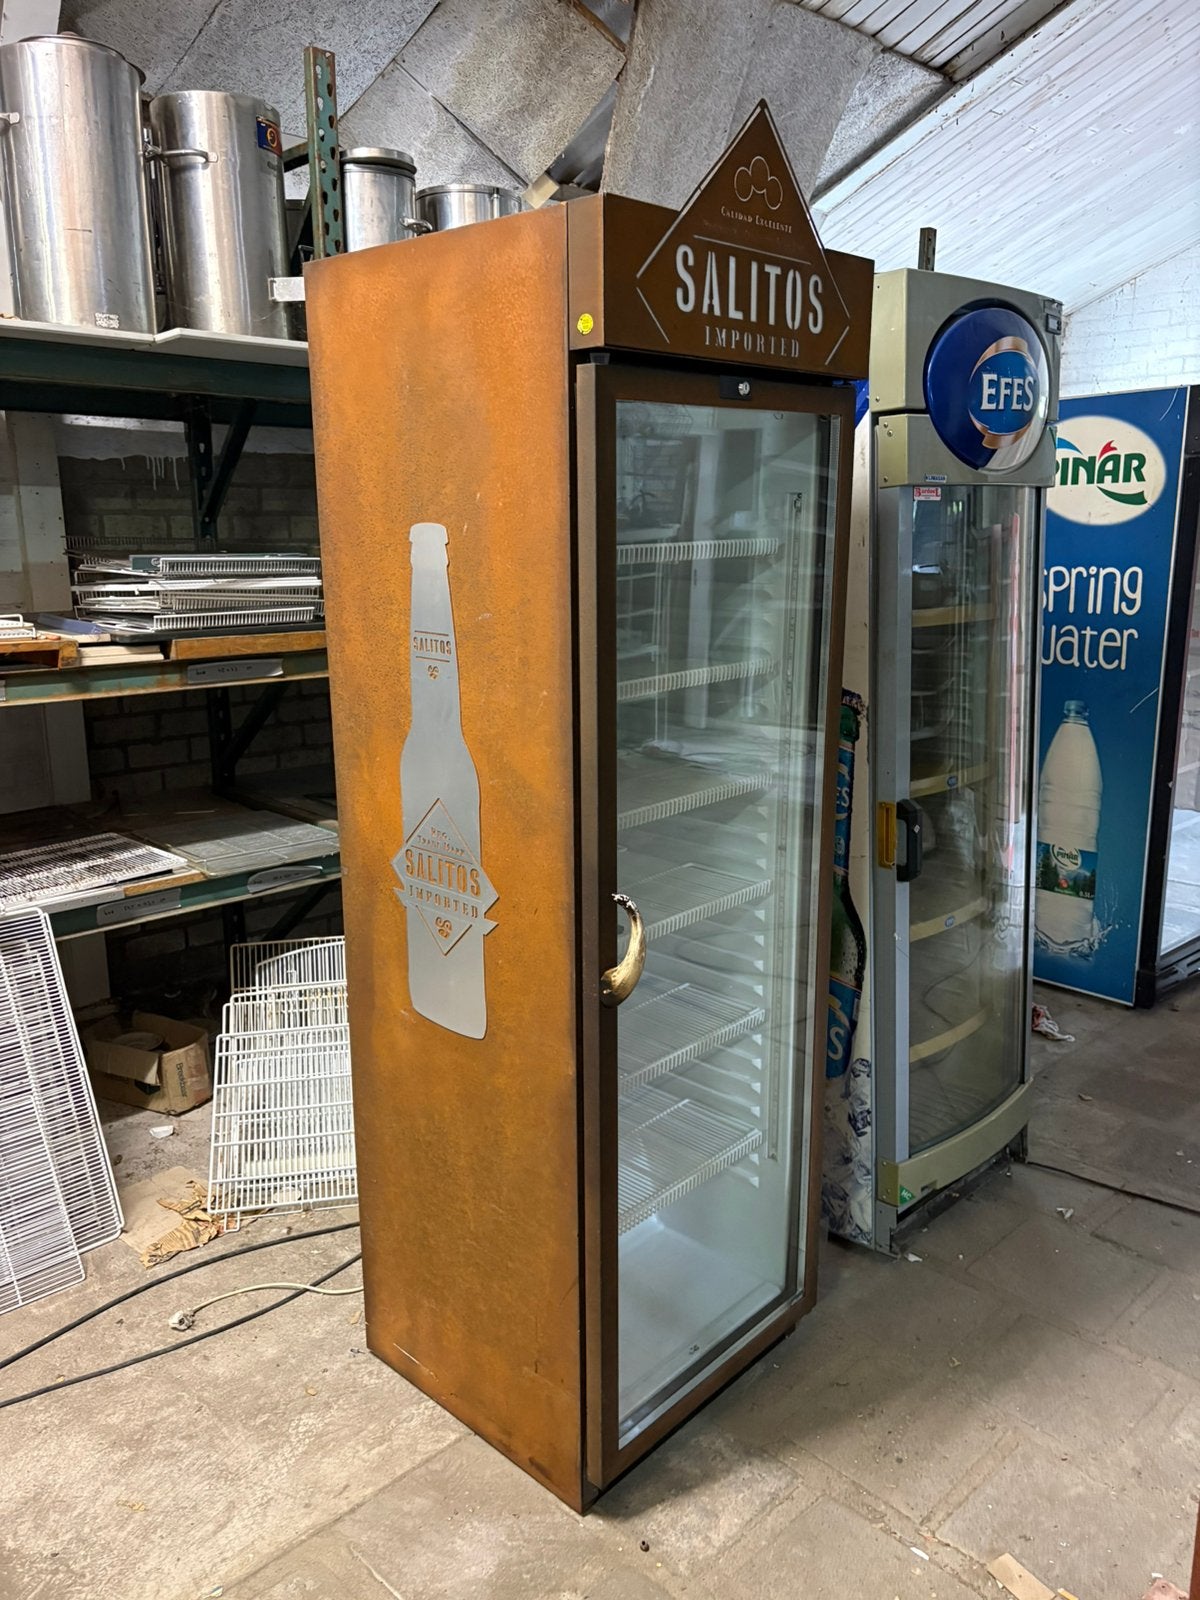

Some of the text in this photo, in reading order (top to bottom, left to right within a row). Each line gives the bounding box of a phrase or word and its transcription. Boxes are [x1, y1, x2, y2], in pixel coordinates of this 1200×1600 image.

[676, 244, 823, 334] SALITOS
[705, 325, 799, 358] IMPORTED
[980, 373, 1034, 412] EFES
[1055, 452, 1147, 486] INAR
[1043, 565, 1143, 616] pring
[413, 636, 452, 656] SALITOS
[405, 848, 480, 897] SALITOS
[409, 885, 478, 918] IMPORTED
